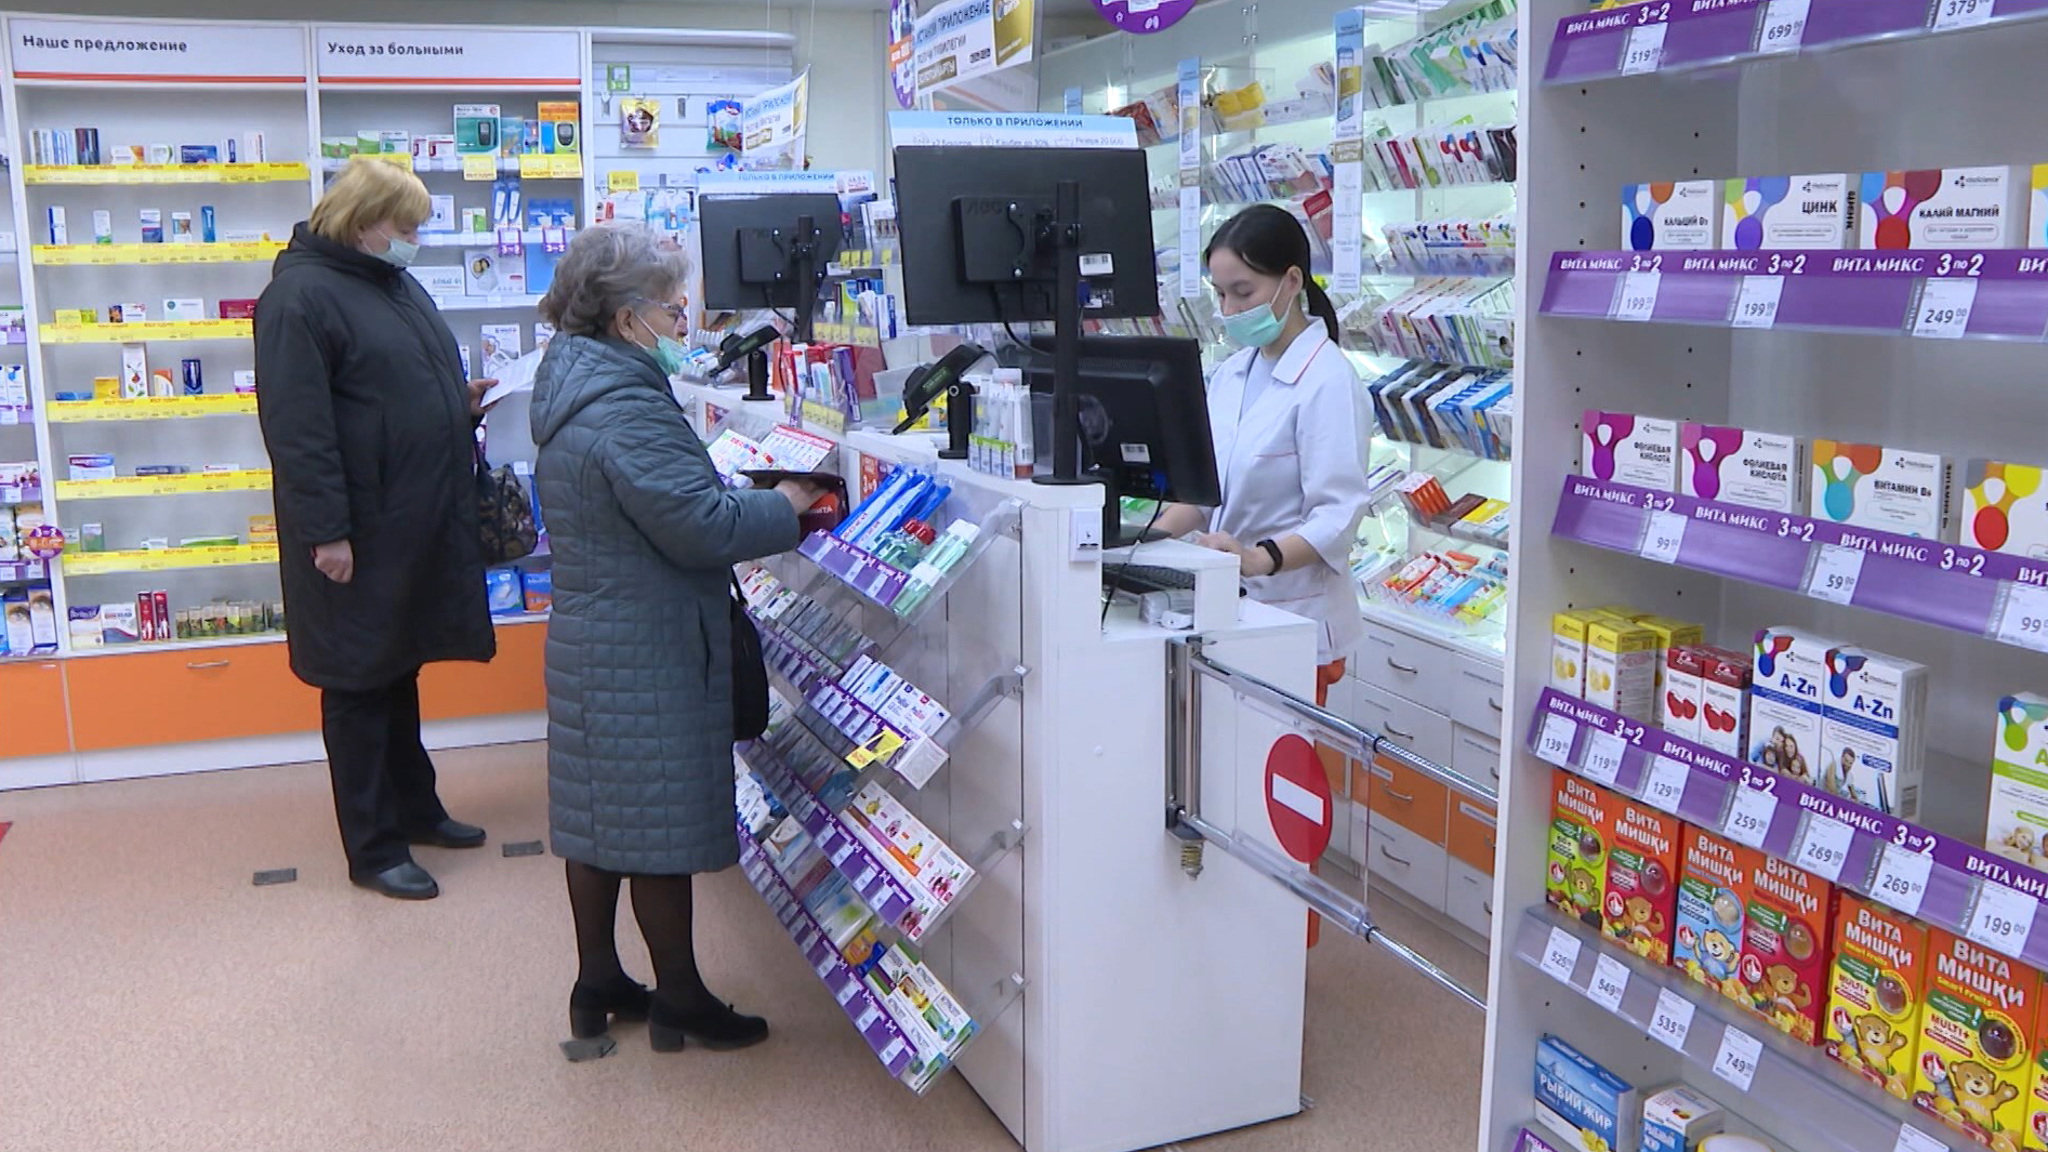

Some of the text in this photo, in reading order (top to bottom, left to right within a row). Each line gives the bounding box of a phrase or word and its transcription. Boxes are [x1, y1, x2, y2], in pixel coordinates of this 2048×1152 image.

[1638, 6, 1649, 24] 3
[1658, 3, 1671, 21] 2
[1946, 0, 1977, 16] 379
[1767, 24, 1792, 40] 699
[23, 35, 188, 53] Наше предложение
[328, 42, 464, 56] Уход за больными
[1630, 50, 1651, 64] 519
[947, 117, 1083, 128] ТОЛЬКО В ПРИЛОЖЕНИИ
[1802, 200, 1838, 214] ЦИНК
[1919, 204, 1999, 218] КАЛИЙ МАГНИЙ
[1664, 215, 1698, 227] КАЛЬЦИЙ
[1630, 255, 1641, 272] 3
[1651, 254, 1663, 273] 2
[1768, 254, 1781, 274] 3
[1793, 254, 1806, 274] 2
[1936, 253, 1953, 276] 3
[1967, 253, 1985, 276] 2
[1625, 297, 1646, 310] 199
[1743, 302, 1766, 317] 199
[1924, 308, 1954, 324] 249
[1874, 479, 1919, 496] ВИТАМИН
[1643, 493, 1654, 510] 3
[1663, 497, 1675, 513] 2
[1776, 517, 1790, 538] 3
[1801, 522, 1815, 542] 2
[1656, 537, 1670, 551] 99
[1940, 547, 1954, 570] 3
[1969, 553, 1986, 577] 2
[1825, 573, 1844, 589] 59
[2019, 616, 2042, 633] 99
[1780, 673, 1818, 697] A-Zn
[1854, 695, 1894, 720] A-Zn
[1614, 719, 1625, 738] 3
[1634, 727, 1645, 746] 2
[1545, 737, 1562, 751] 139
[1593, 755, 1611, 769] 119
[1653, 782, 1673, 797] 129
[1739, 767, 1752, 786] 3
[1761, 776, 1776, 796] 2
[1733, 812, 1757, 830] 259
[1893, 823, 1908, 845] 3
[1922, 834, 1937, 858] 2
[1807, 843, 1833, 862] 269
[1882, 874, 1910, 896] 269
[1984, 913, 2012, 936] 199
[1598, 978, 1616, 996] 549
[1656, 1015, 1677, 1034] 535
[1726, 1052, 1746, 1073] 749
[1583, 1103, 1613, 1130] ЖИР
